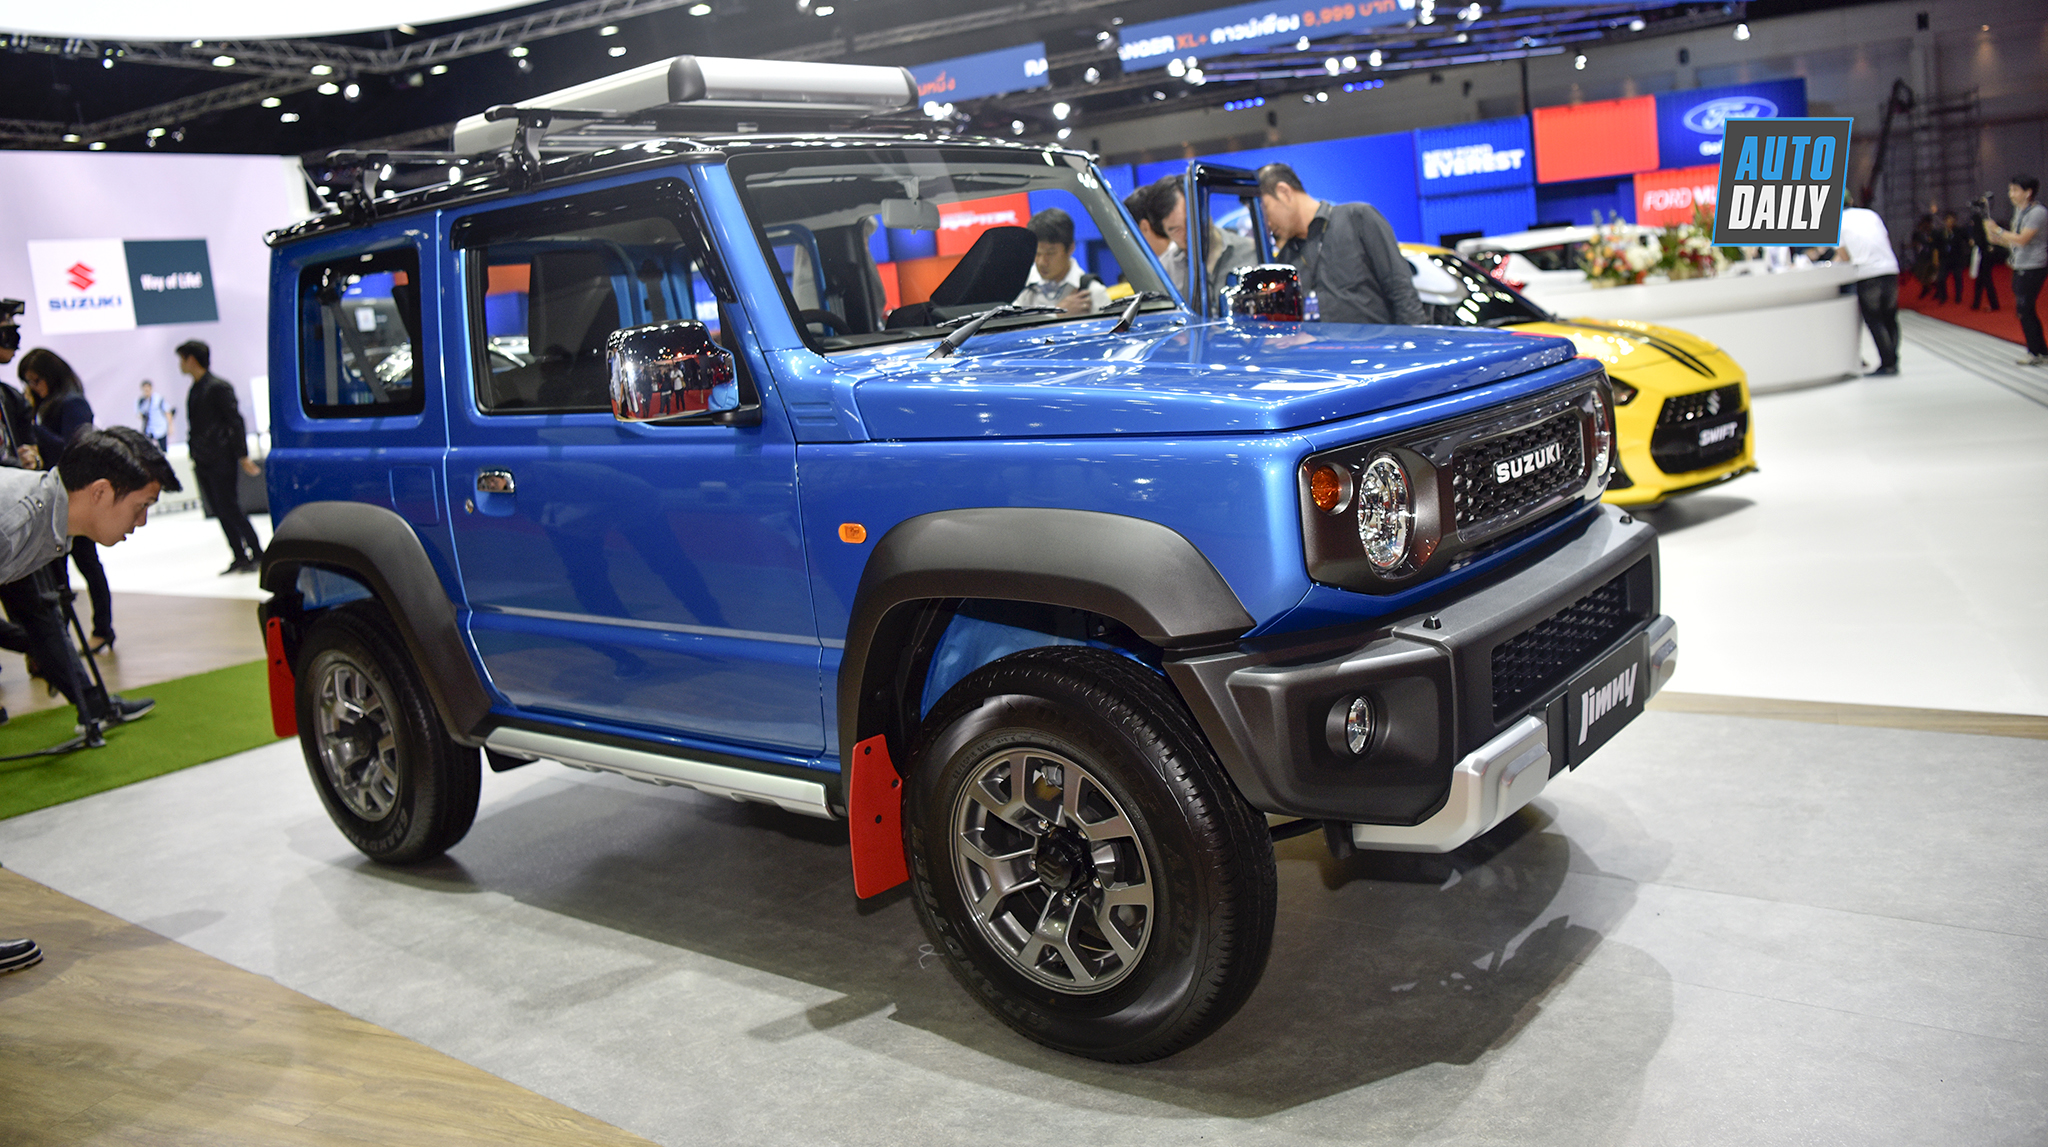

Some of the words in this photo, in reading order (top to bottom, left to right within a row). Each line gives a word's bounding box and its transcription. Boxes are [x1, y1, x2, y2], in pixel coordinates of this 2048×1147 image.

[1423, 149, 1525, 179] EVEREST
[1642, 186, 1692, 212] FORD
[165, 272, 178, 290] of
[49, 296, 122, 311] SUZUKI
[1698, 421, 1738, 447] SWIFT
[1496, 442, 1561, 484] SUZUKI
